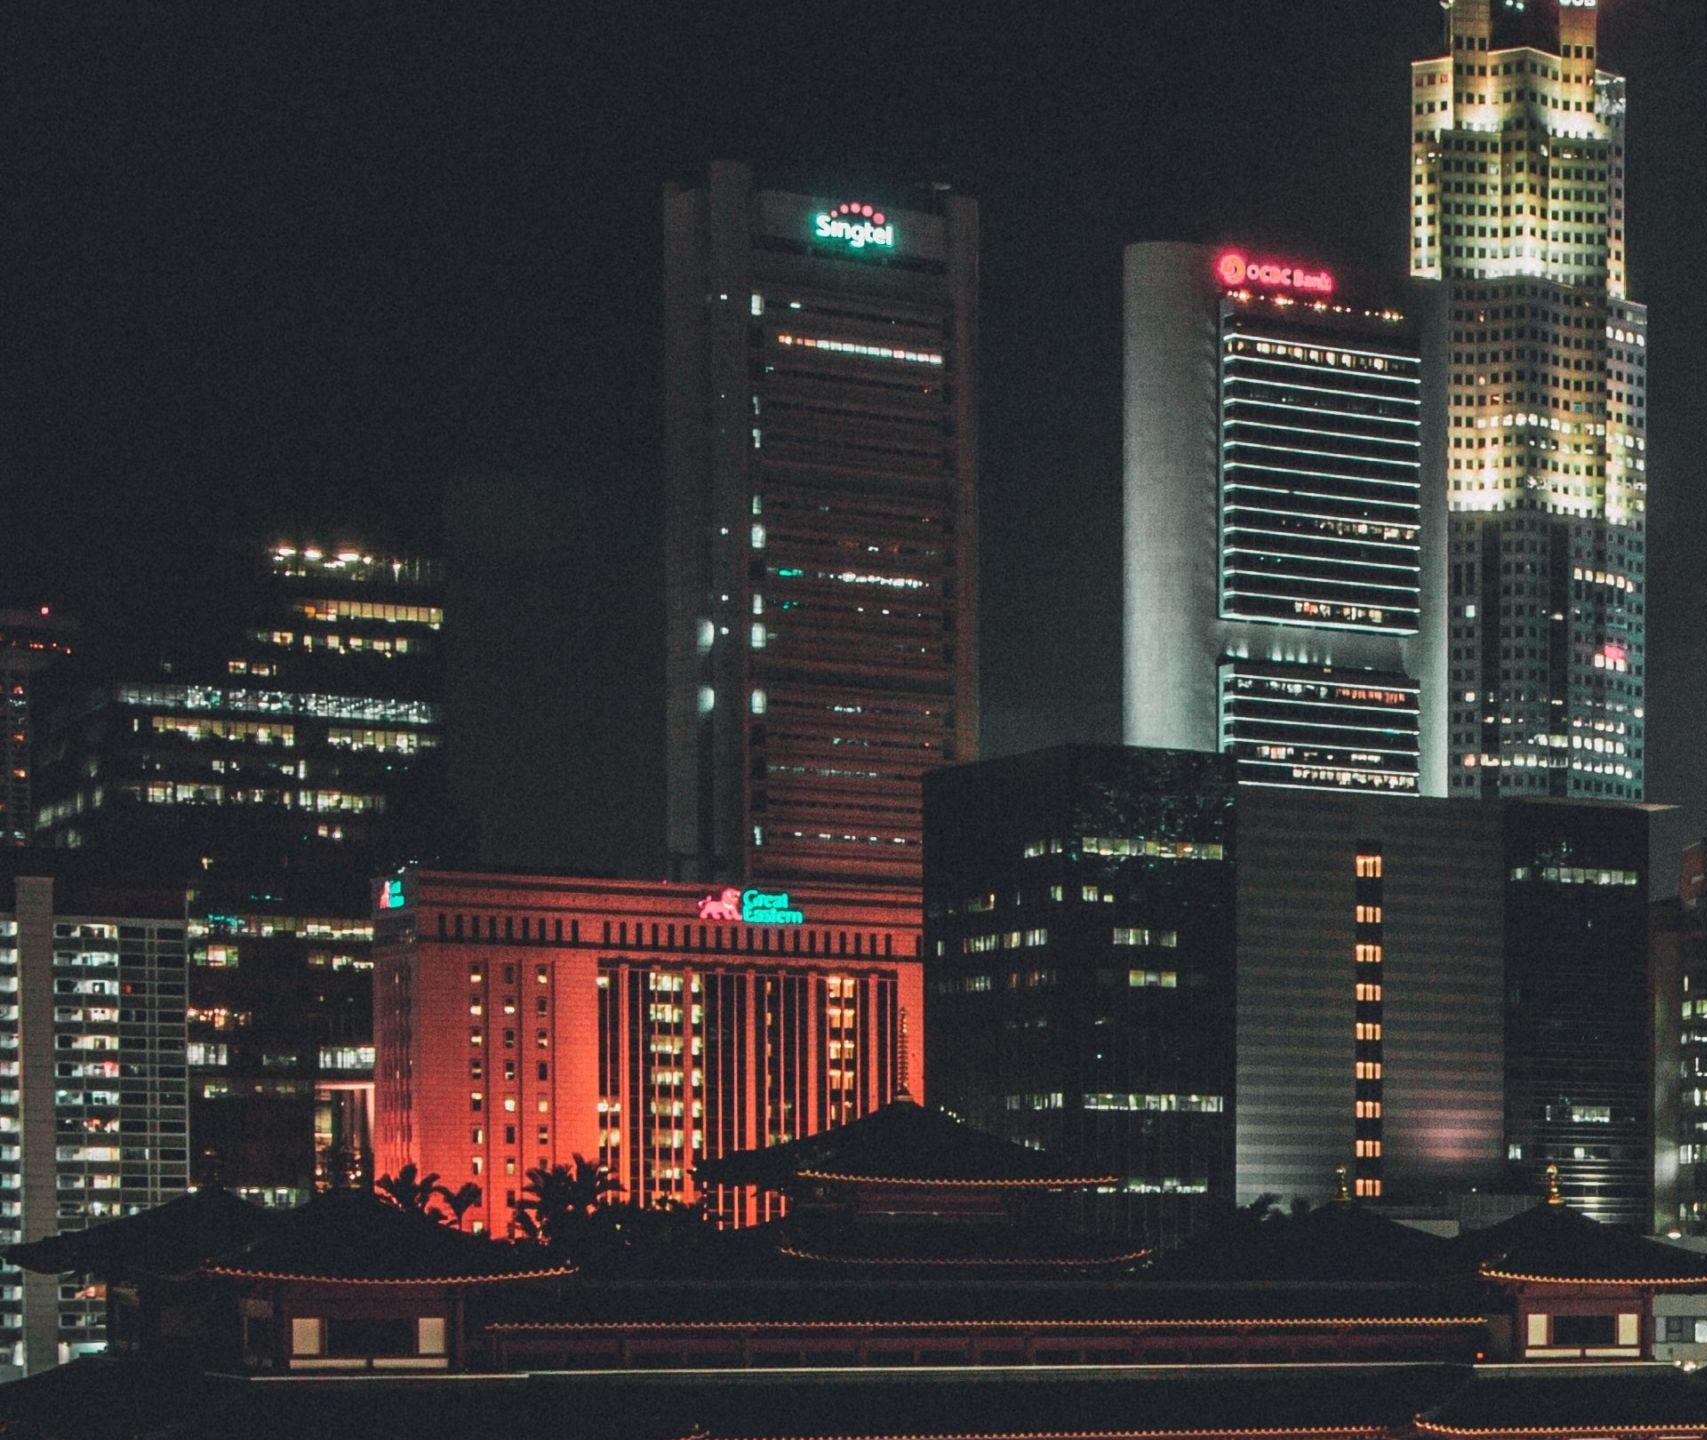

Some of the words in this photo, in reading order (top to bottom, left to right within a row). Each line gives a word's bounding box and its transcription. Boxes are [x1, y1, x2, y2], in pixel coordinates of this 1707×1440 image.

[816, 213, 894, 248] Singtel
[1246, 264, 1292, 286] OCBC
[1293, 269, 1333, 292] Bank
[743, 889, 788, 909] Great
[743, 906, 804, 924] Eastern
